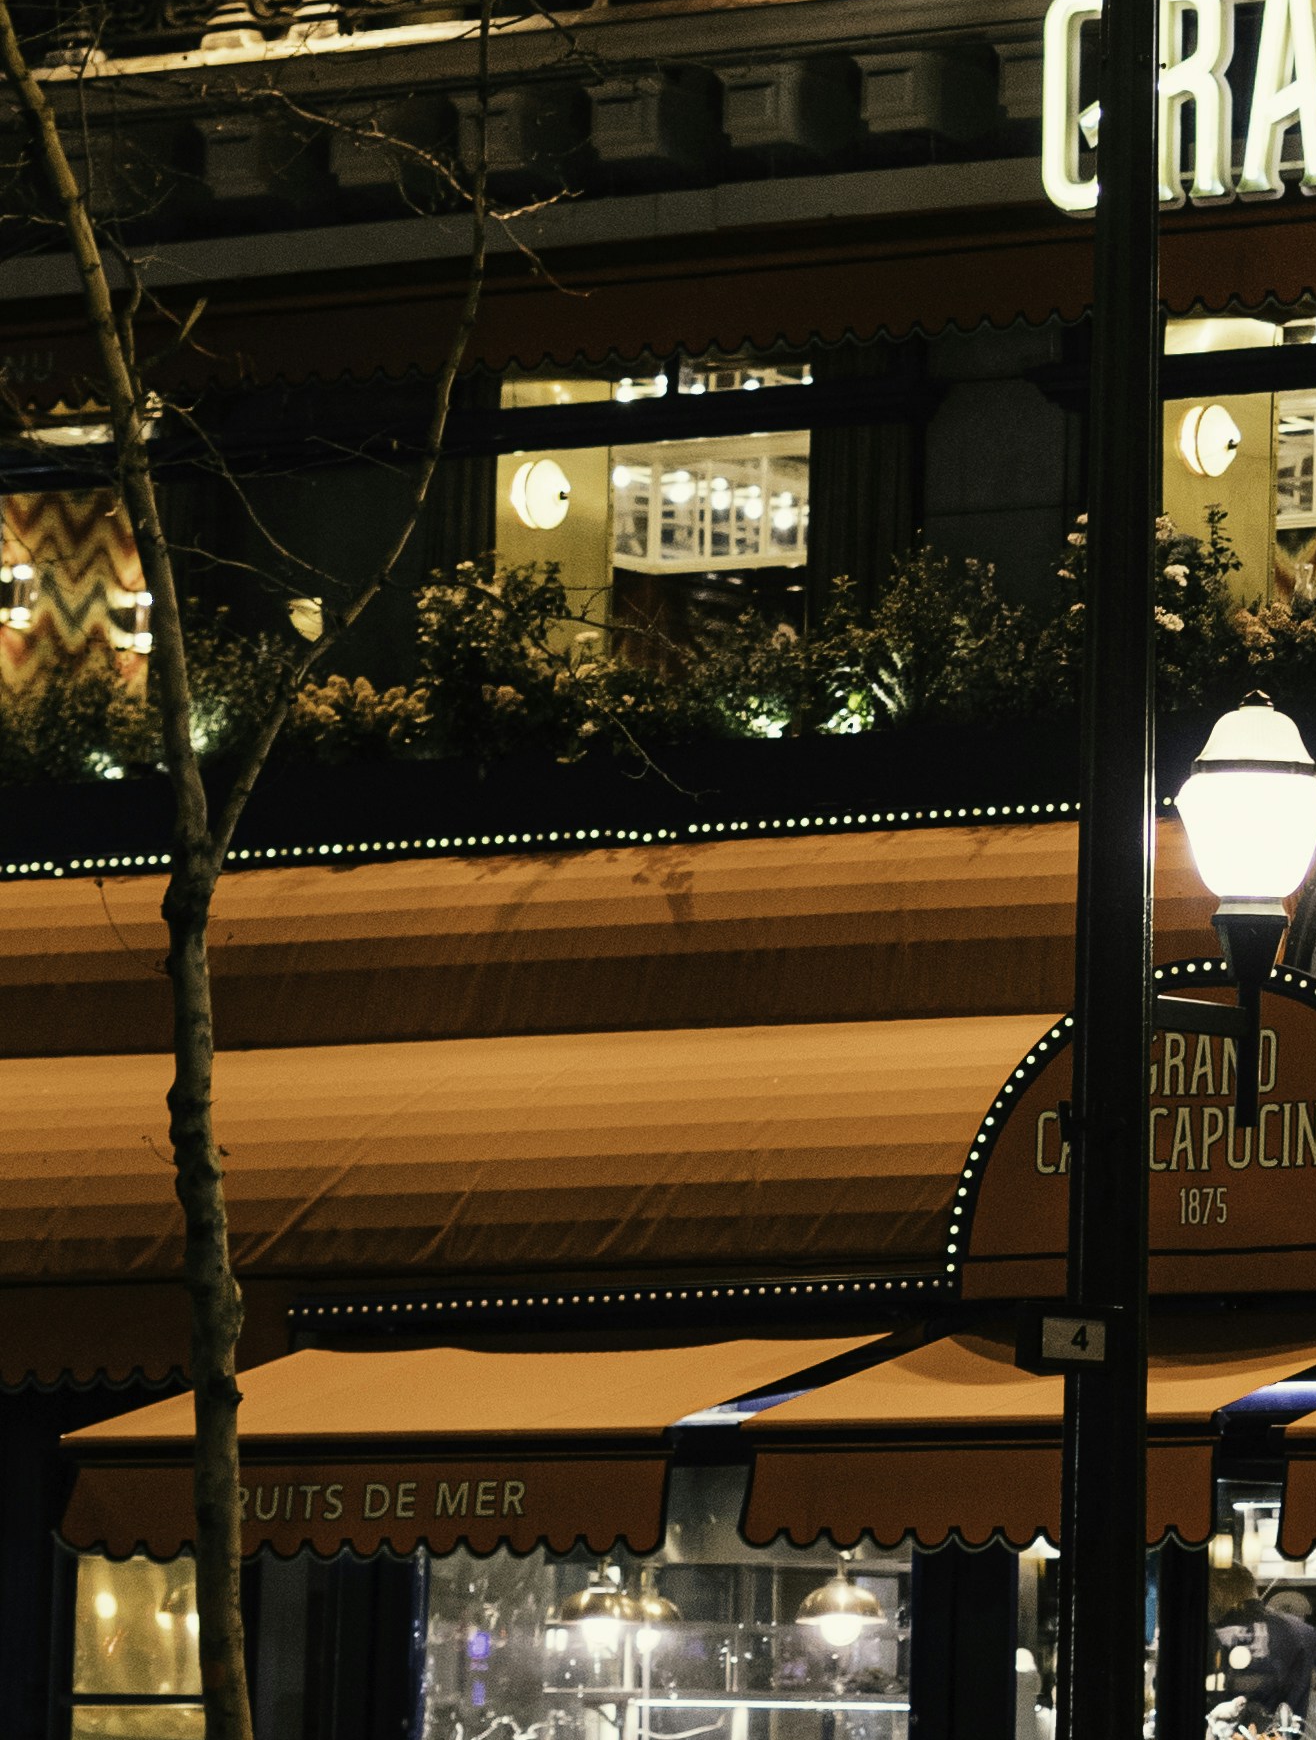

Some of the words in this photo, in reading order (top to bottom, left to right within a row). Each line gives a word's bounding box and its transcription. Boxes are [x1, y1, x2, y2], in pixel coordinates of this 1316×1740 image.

[1178, 1187, 1229, 1226] 1875
[1070, 1325, 1090, 1352] 4
[236, 1481, 345, 1522] RUITS
[361, 1480, 418, 1521] DE
[434, 1479, 528, 1518] MER
